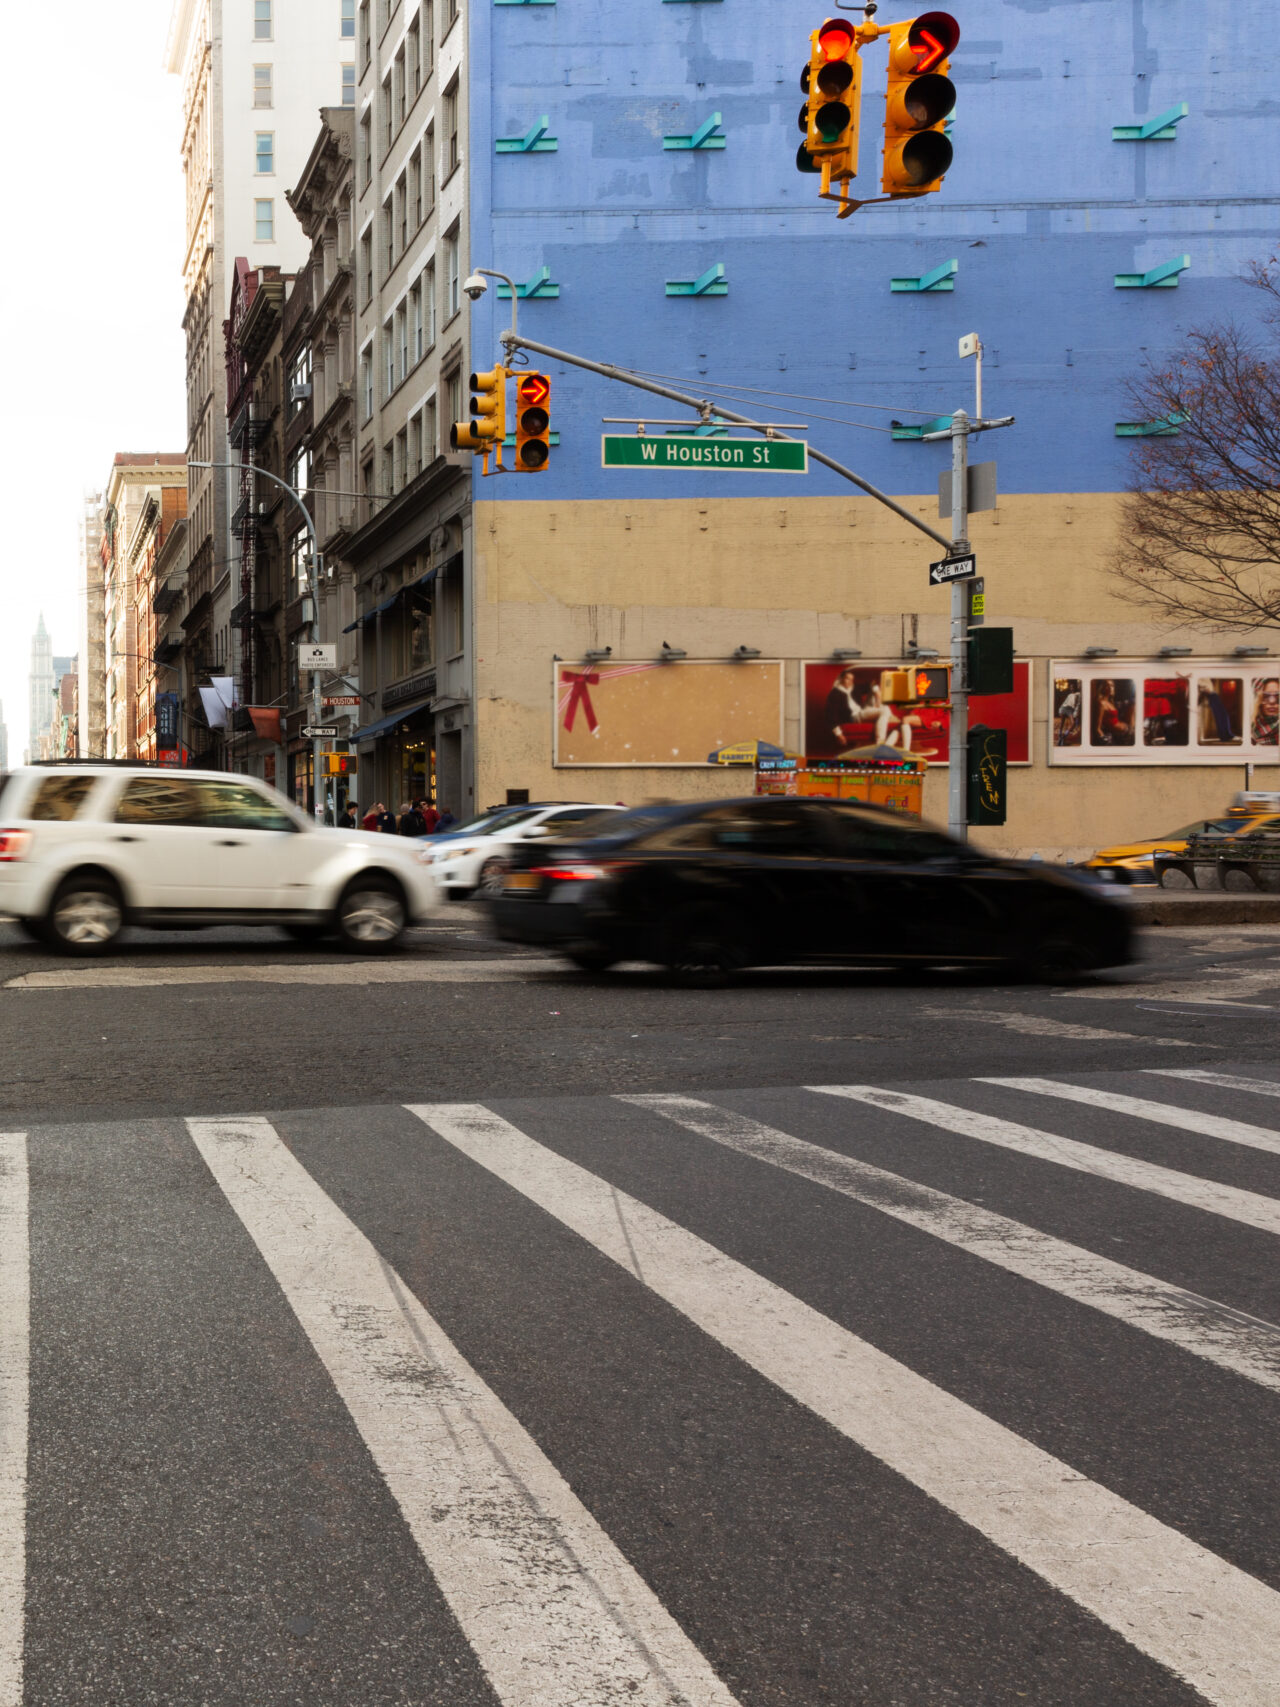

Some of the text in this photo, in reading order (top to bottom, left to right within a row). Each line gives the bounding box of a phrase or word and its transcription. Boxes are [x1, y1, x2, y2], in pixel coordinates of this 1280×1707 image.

[640, 443, 770, 464] W Houston St
[936, 562, 970, 578] ONE WAY
[329, 697, 355, 705] HOUSTON
